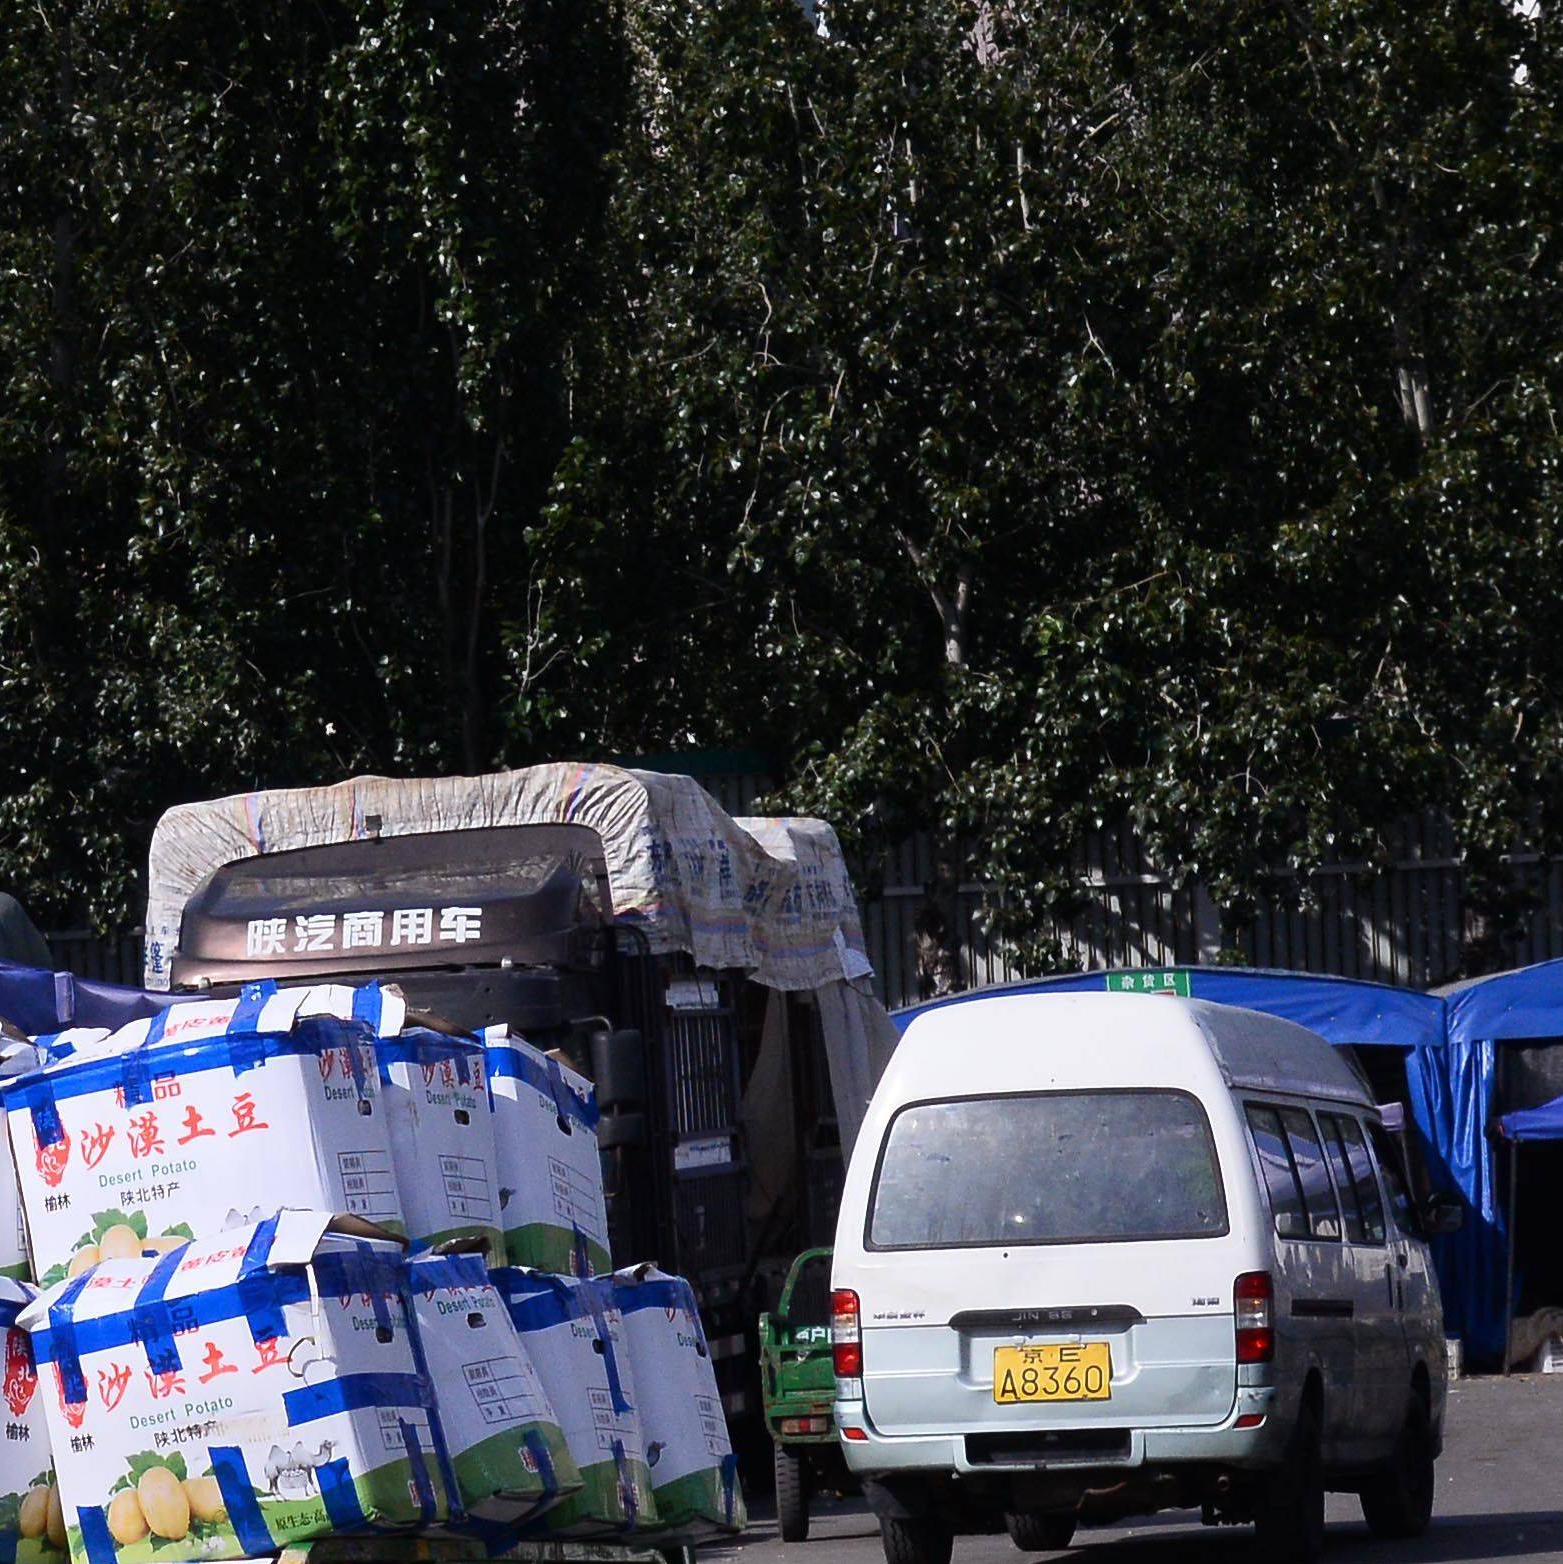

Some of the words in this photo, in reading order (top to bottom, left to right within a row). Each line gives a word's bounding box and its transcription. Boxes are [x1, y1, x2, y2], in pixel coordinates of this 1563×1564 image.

[247, 907, 483, 956] 陕汽商用车
[81, 1092, 269, 1171] 沙漠土豆
[98, 1165, 143, 1188] Desert
[151, 1158, 197, 1177] Potato
[45, 1193, 71, 1212] 榆林
[120, 1181, 180, 1206] 陕北特产
[98, 1335, 293, 1412] 沙漠土豆
[1000, 1365, 1104, 1400] A8360
[130, 1407, 175, 1430] Desert
[185, 1396, 233, 1416] Potato
[6, 1422, 30, 1441] 榆林
[71, 1433, 95, 1453] 榆林
[154, 1420, 217, 1448] 陕北特产
